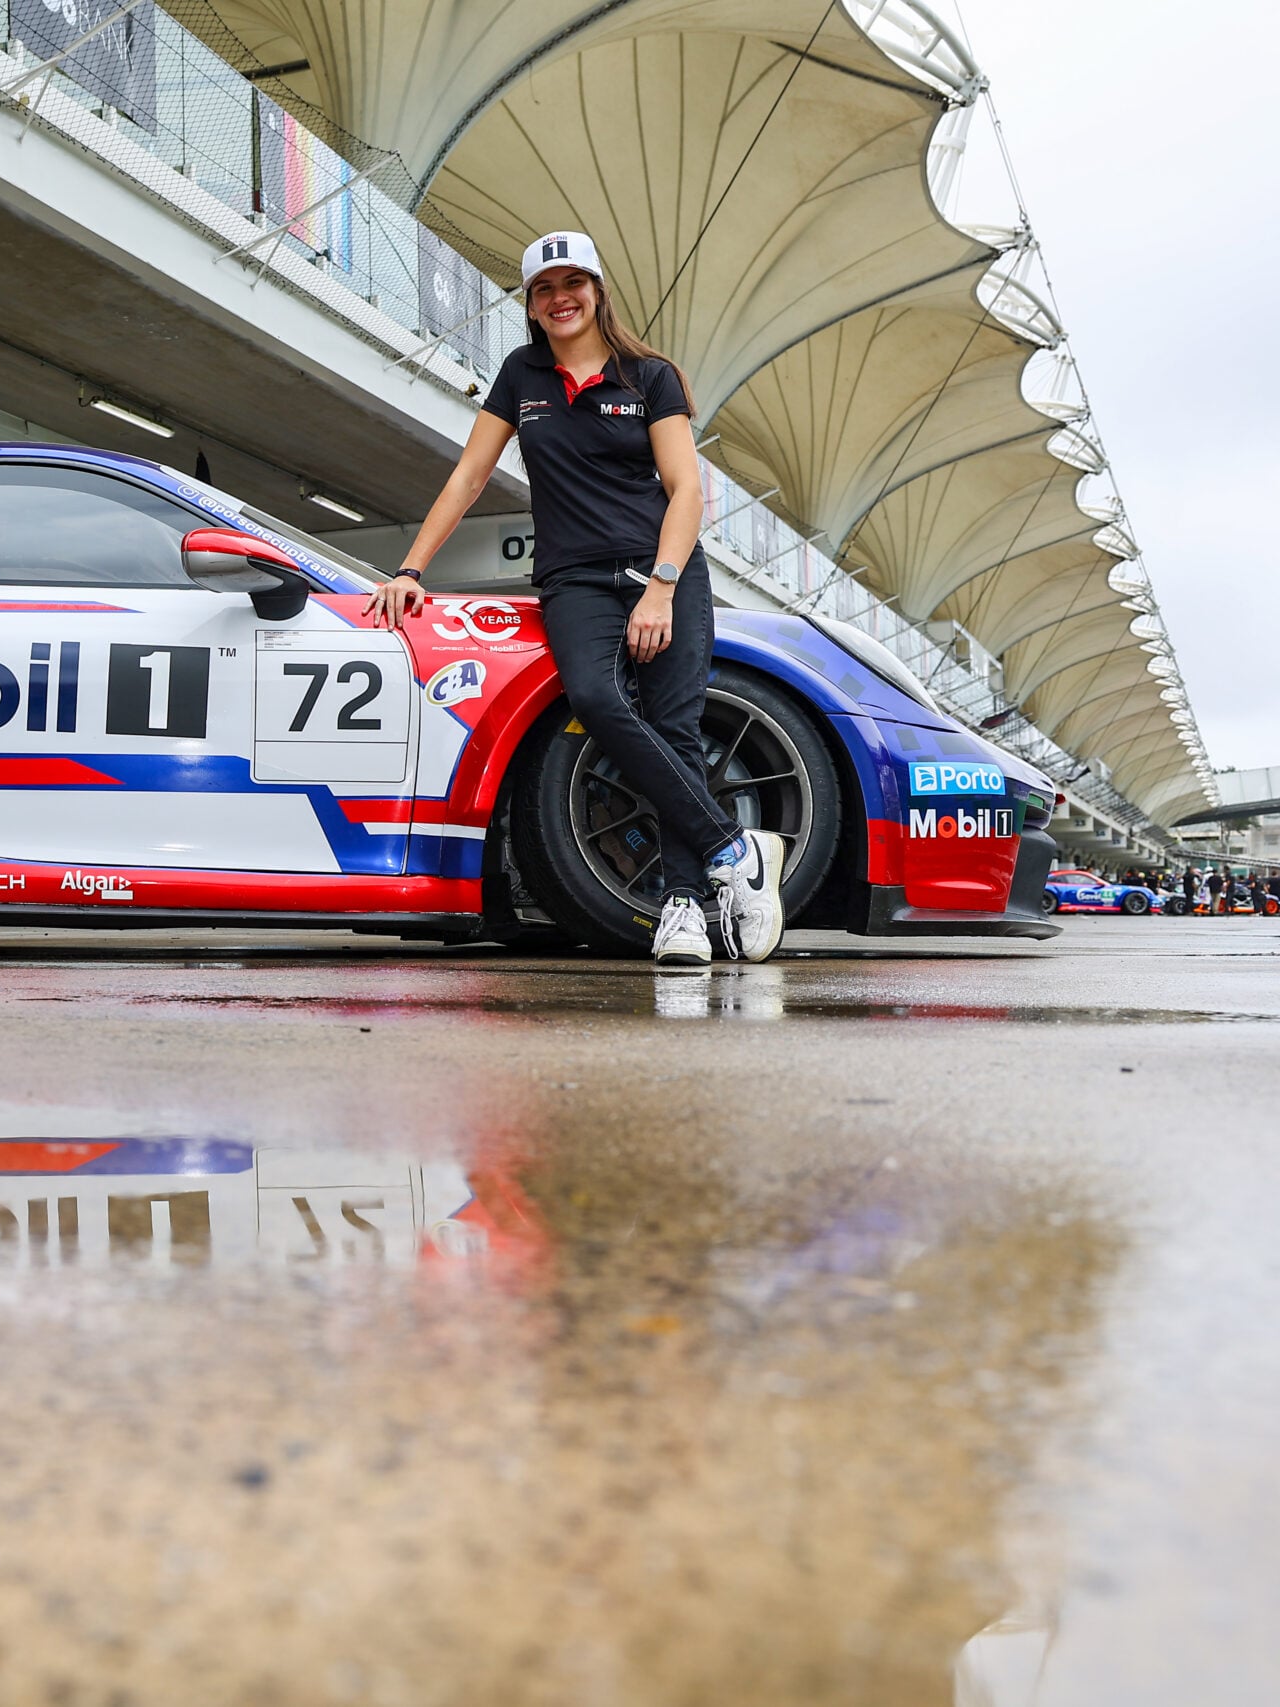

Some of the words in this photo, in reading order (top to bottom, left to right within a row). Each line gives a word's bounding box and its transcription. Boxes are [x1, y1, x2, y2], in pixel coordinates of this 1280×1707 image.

[542, 235, 568, 244] Mobil
[600, 404, 636, 415] Mobil
[198, 496, 339, 582] @porschecupbrasil
[479, 615, 521, 625] YEARS
[489, 644, 514, 652] Mobil
[139, 651, 168, 730] 1
[433, 662, 478, 700] CBA
[284, 661, 382, 731] 72
[939, 766, 1002, 790] Porto
[910, 809, 991, 838] Mobil
[61, 871, 116, 896] Algar
